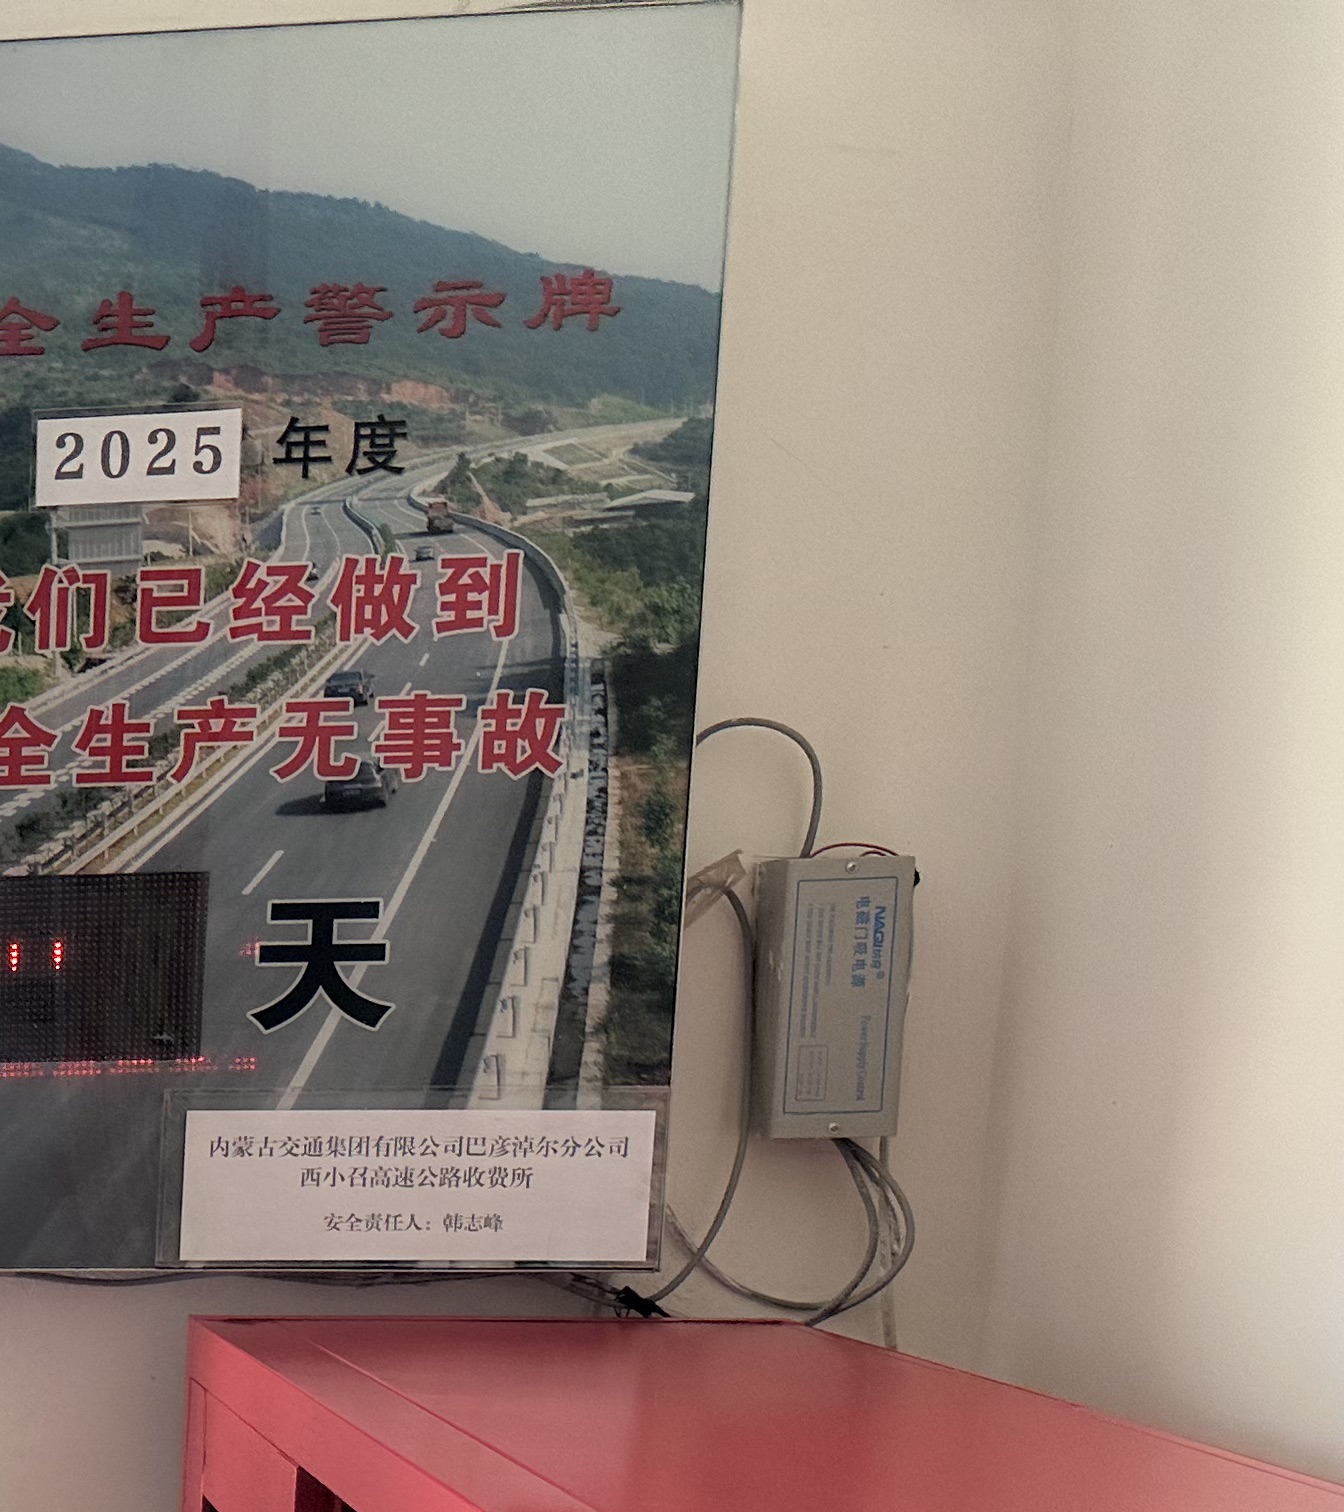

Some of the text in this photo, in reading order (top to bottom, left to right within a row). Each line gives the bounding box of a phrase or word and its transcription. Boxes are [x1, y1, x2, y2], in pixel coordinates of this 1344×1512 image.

[53, 414, 409, 482] 2025 年度
[247, 897, 395, 1034] 天
[209, 1135, 630, 1159] 内蒙古交通集团有限公司巴彦淖尔分公司
[300, 1166, 534, 1189] 西小召高速公路收费所
